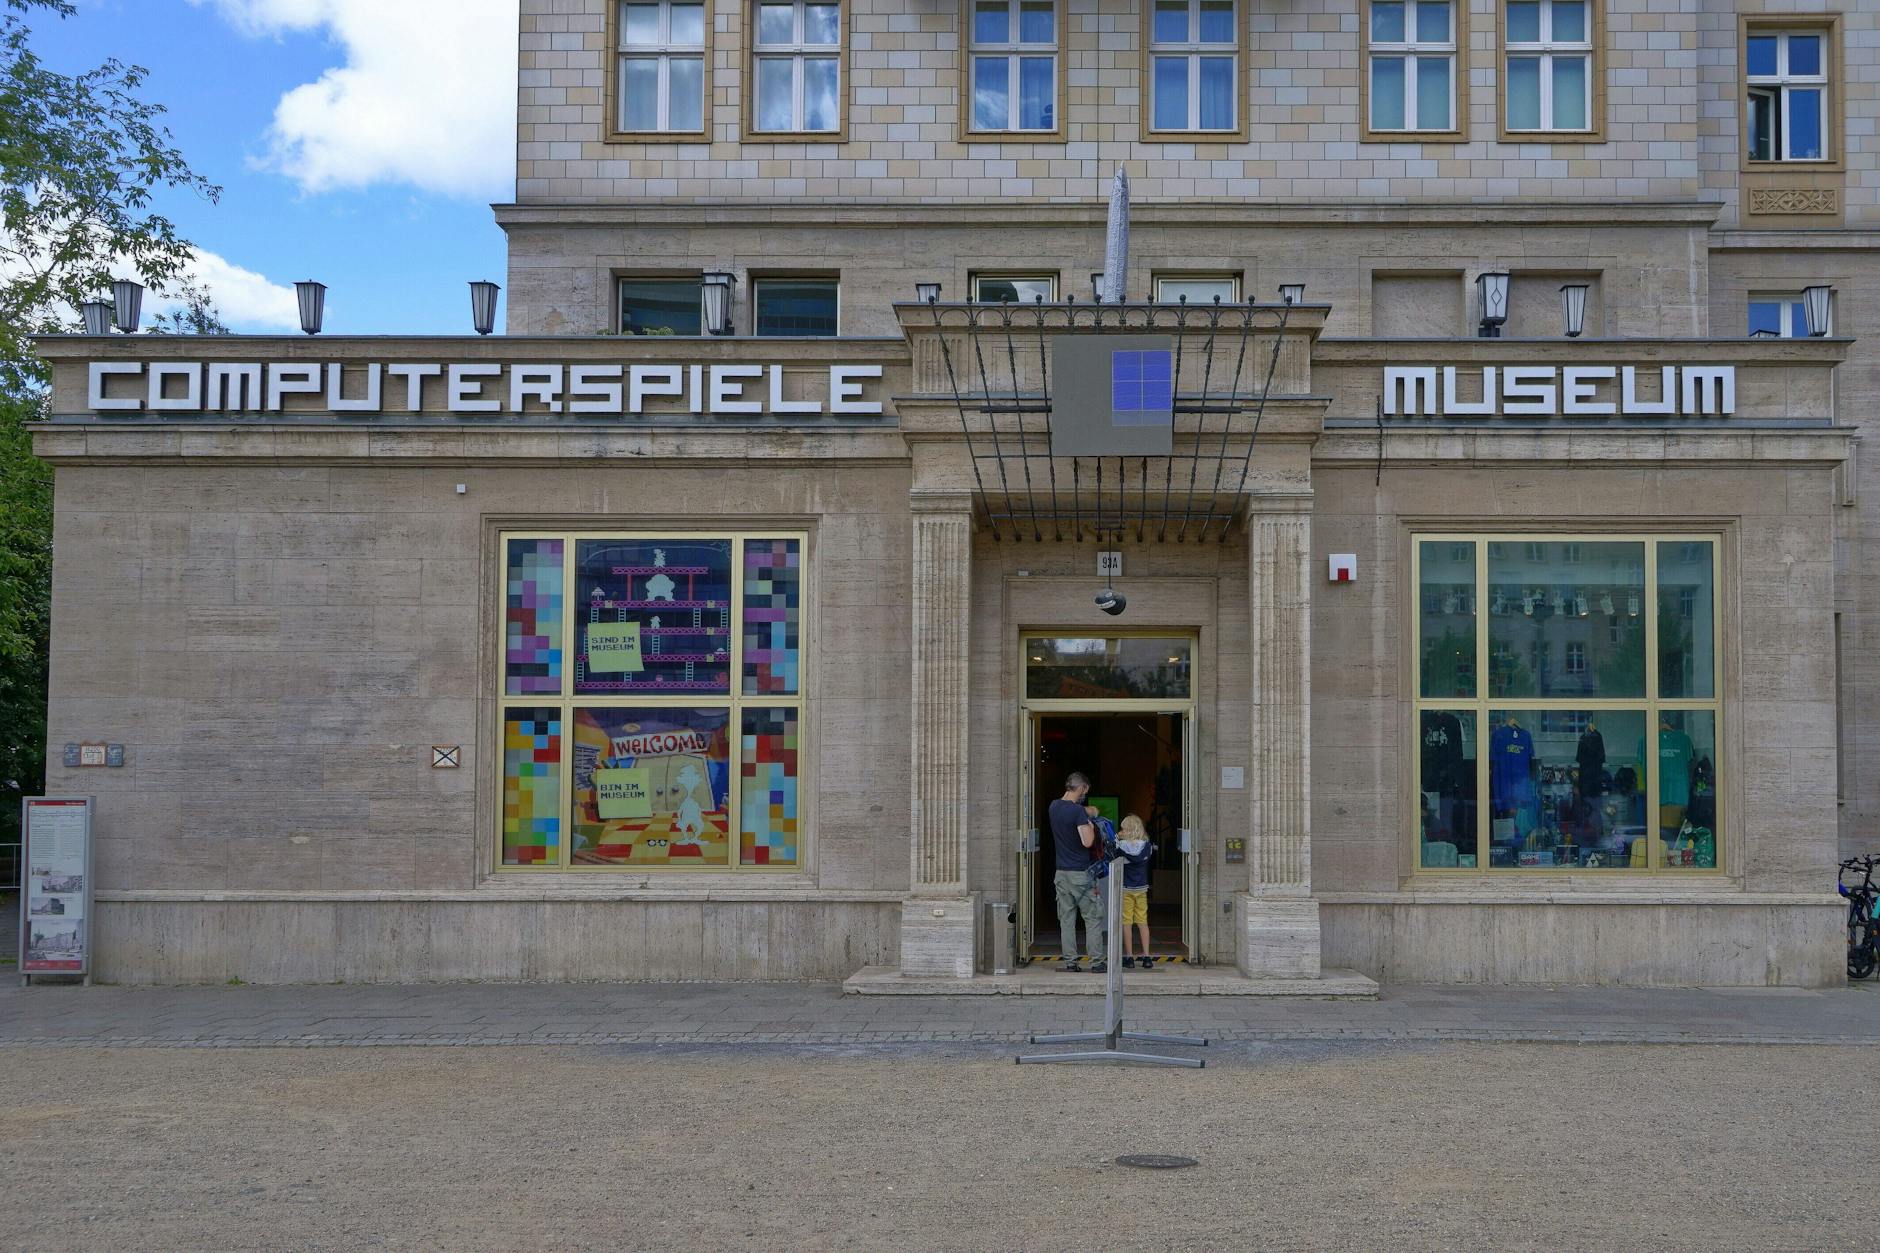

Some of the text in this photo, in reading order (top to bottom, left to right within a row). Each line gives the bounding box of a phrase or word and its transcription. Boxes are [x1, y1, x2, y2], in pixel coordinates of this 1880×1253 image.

[88, 362, 1735, 414] COMPUTERSPIELE MUSEUM
[1102, 557, 1118, 568] 93A
[591, 636, 619, 644] SIND
[600, 783, 639, 791] BIN IM
[600, 791, 645, 799] MUSEUM
